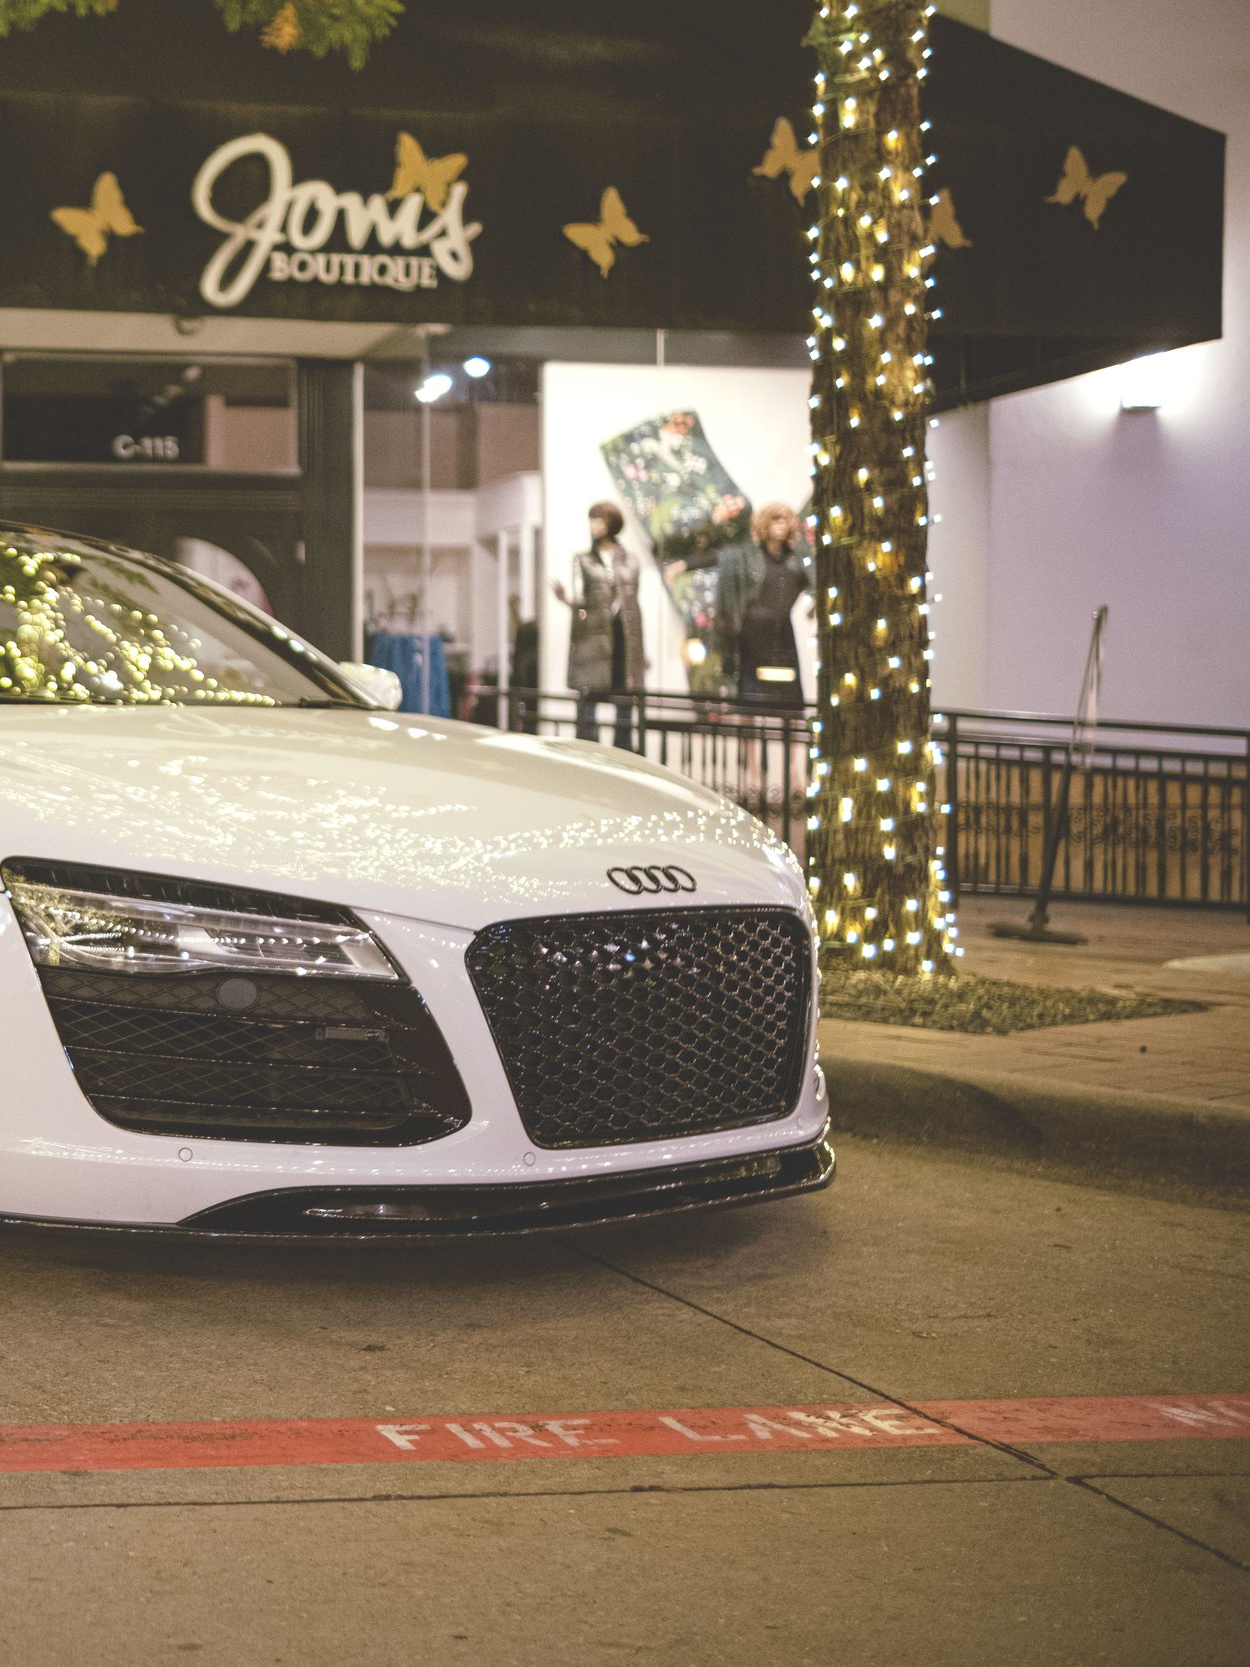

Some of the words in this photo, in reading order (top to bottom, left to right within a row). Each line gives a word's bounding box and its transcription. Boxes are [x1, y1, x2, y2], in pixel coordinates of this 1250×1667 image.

[267, 251, 438, 290] BOUTIQUE
[112, 434, 179, 459] C-115
[375, 1418, 621, 1450] FIRE
[657, 1408, 941, 1442] LANE
